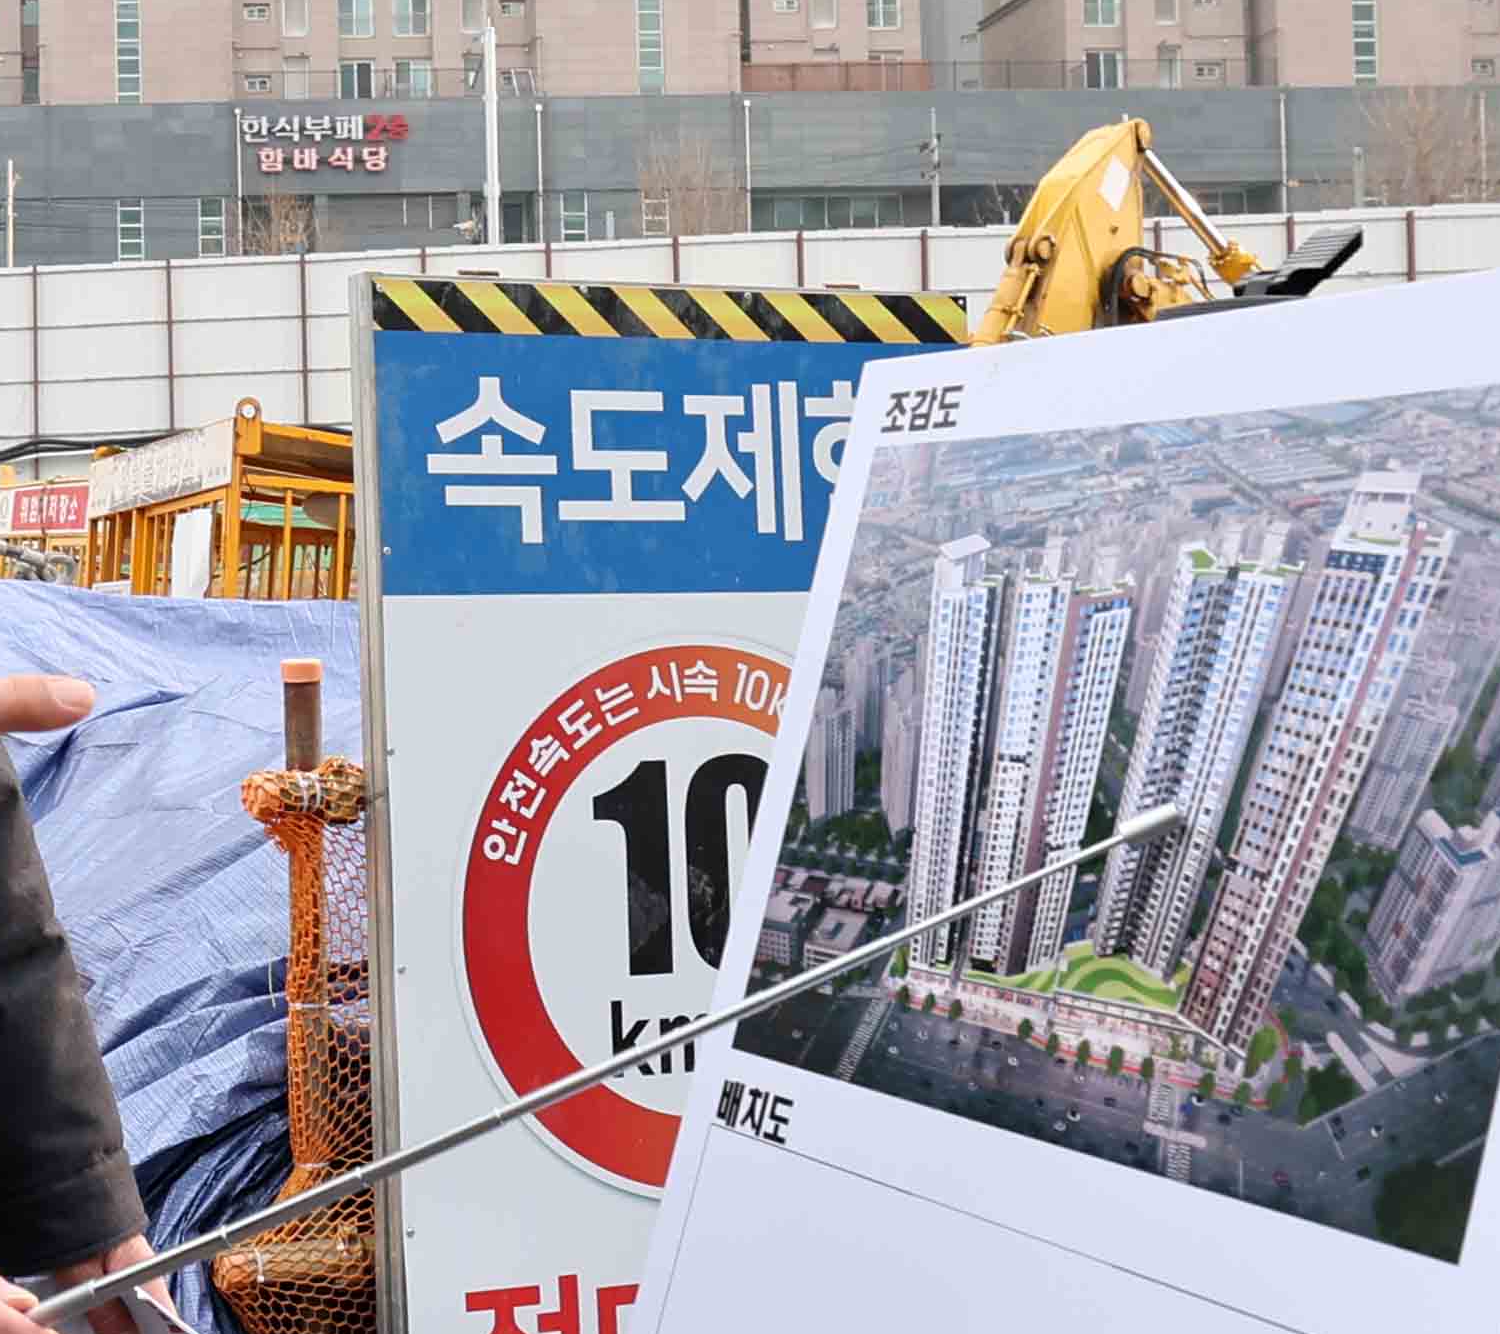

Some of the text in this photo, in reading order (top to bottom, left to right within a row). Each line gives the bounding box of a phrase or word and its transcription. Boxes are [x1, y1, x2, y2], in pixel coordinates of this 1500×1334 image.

[880, 384, 964, 433] 조감도
[482, 682, 640, 866] 안전속도는
[647, 660, 720, 703] 시속
[716, 1078, 791, 1144] 배치도
